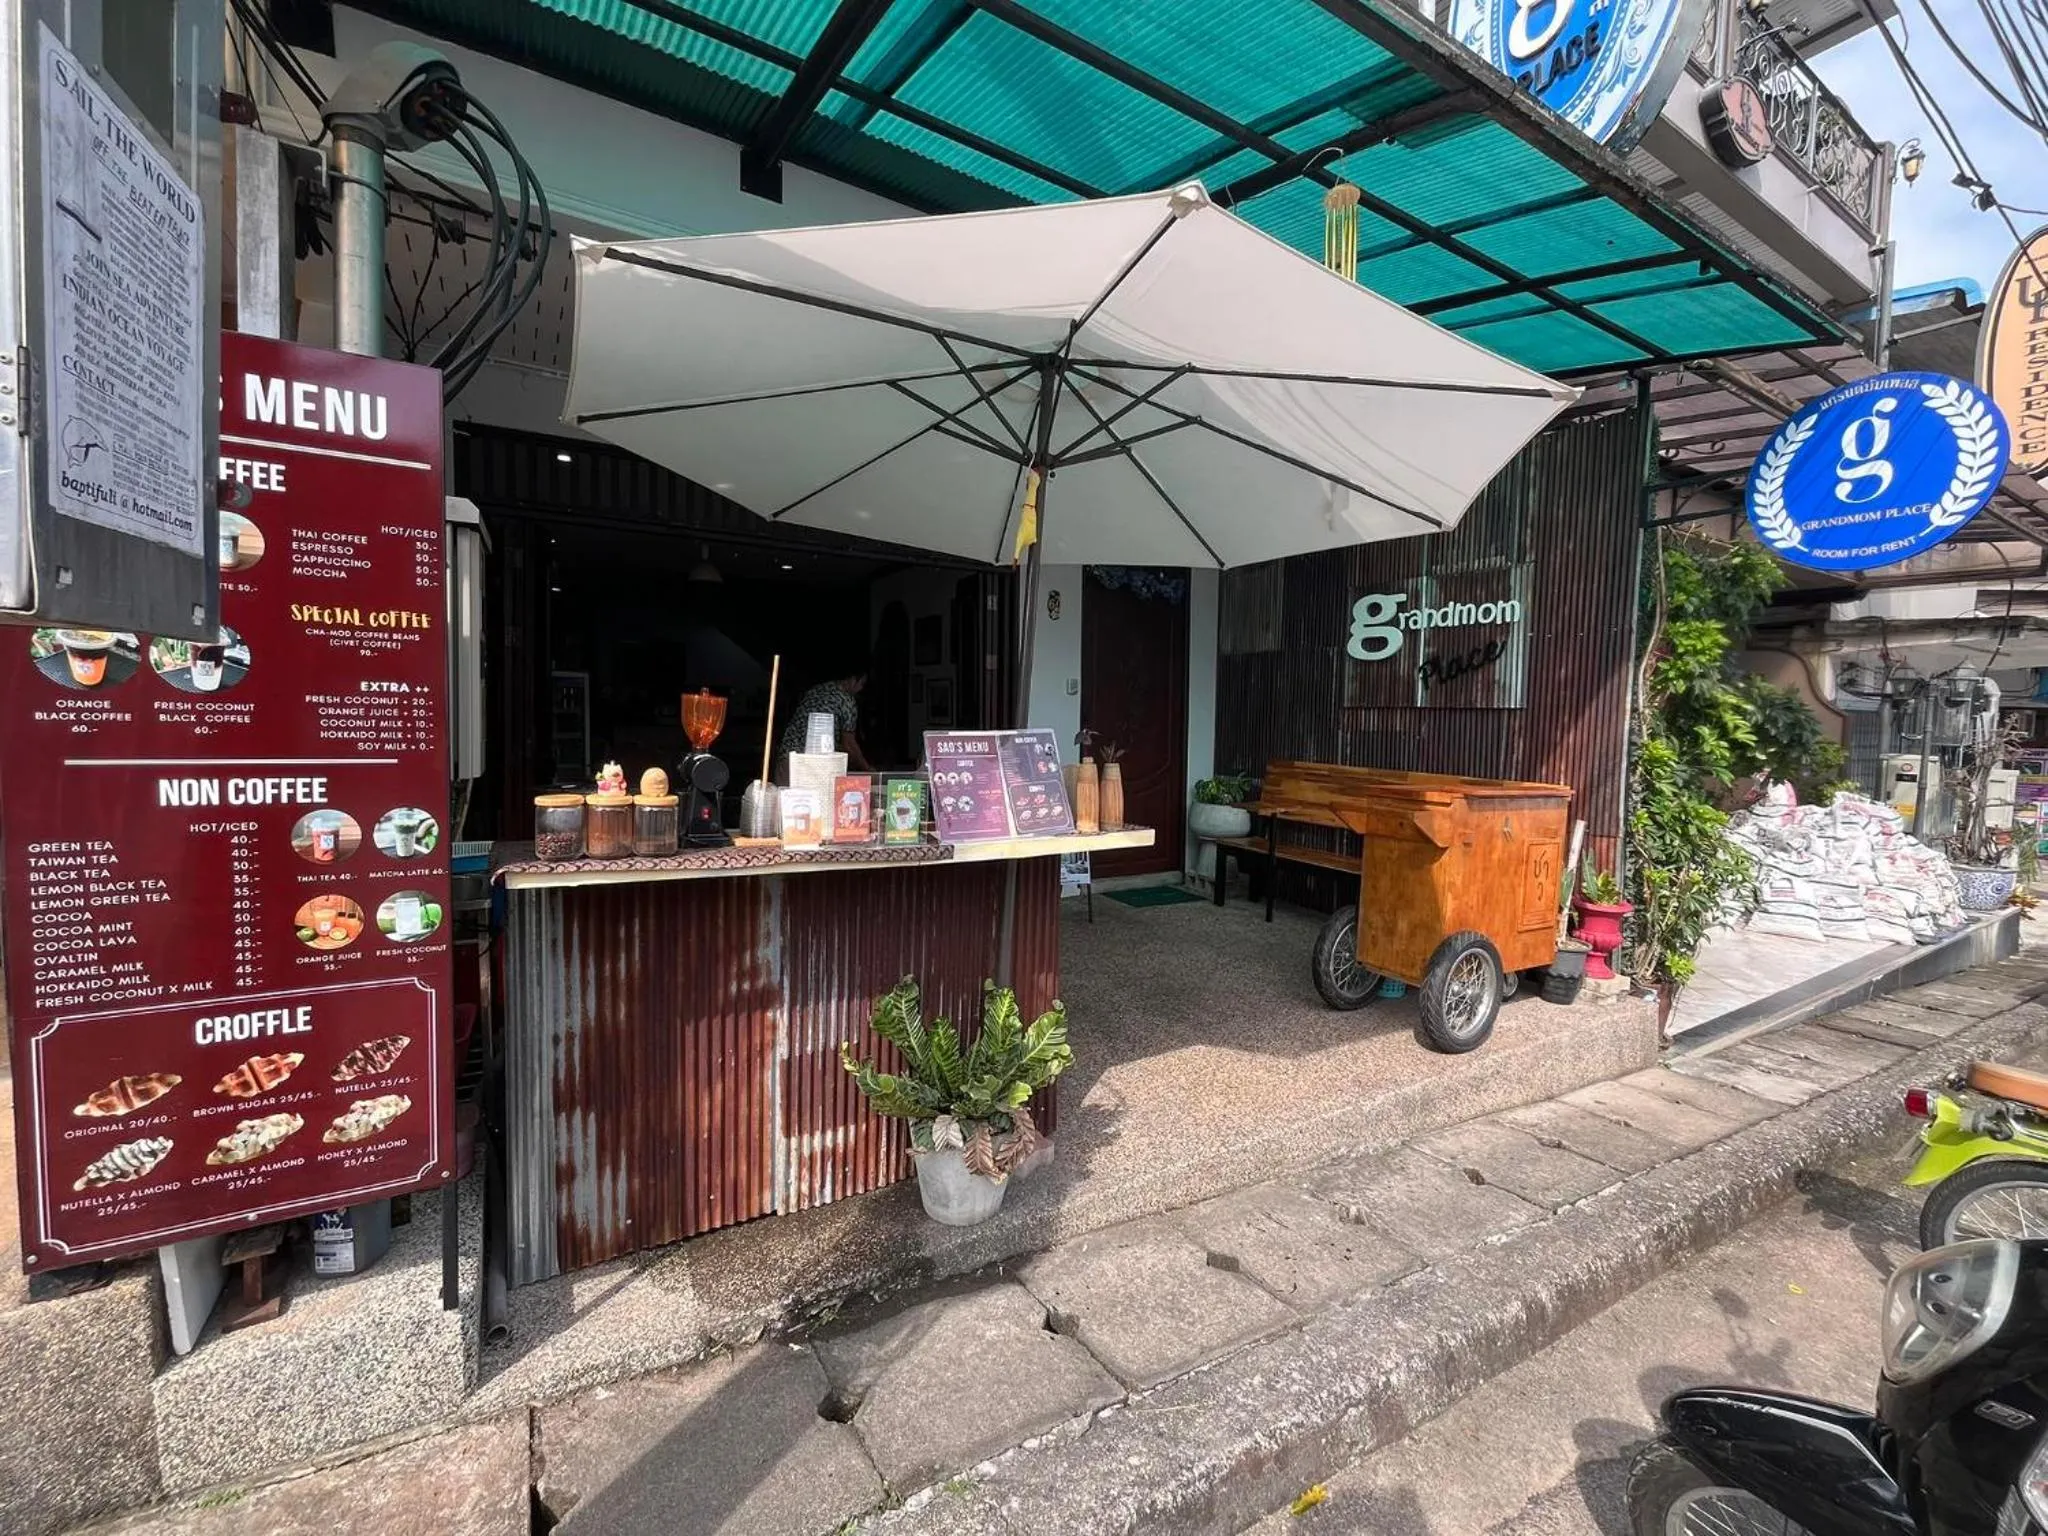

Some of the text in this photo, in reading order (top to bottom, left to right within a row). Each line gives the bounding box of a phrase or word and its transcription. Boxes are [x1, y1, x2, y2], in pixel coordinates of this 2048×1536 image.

[55, 59, 100, 125] SAIL
[103, 112, 138, 166] THE
[142, 155, 195, 224] WORLD
[86, 250, 110, 278] JOIN
[113, 273, 132, 296] SEA
[135, 291, 186, 339] ADVENTURE
[62, 273, 105, 316] INDIAN
[108, 308, 145, 344] OCEAN
[147, 335, 185, 375] VOYAGE
[63, 355, 115, 395] CONTACT
[245, 374, 387, 440] MENU
[1834, 397, 1899, 504] g
[219, 457, 285, 491] FFEE
[132, 498, 193, 532] hotmail.com
[1801, 503, 1933, 532] GRANDMOM PLACE
[292, 529, 317, 538] THAI
[322, 532, 367, 544] COFFEE
[382, 526, 437, 538] HOT/ICED
[292, 542, 353, 555] ESPRESSO
[1811, 536, 1918, 559] ROOM FOR RENT
[293, 554, 371, 568] CAPPUCCINO
[291, 604, 430, 628] SPECIAL COFFEE
[1347, 593, 1520, 660] grandmom
[355, 631, 388, 639] COFFEE
[361, 681, 409, 692] EXTRA
[56, 700, 110, 708] ORANGE
[154, 701, 254, 711] FRESH COCONUT
[306, 695, 340, 703] FRESH
[344, 696, 398, 704] COCONUT
[35, 712, 131, 721] BLACK COFFEE
[205, 715, 250, 723] COFFEE
[319, 707, 364, 715] ORANGE
[370, 708, 398, 716] JUICE
[320, 719, 375, 727] COCONUT
[358, 742, 380, 750] SOY
[964, 742, 989, 753] MENU
[159, 778, 327, 806] NON COFFEE
[190, 822, 258, 833] HOT/ICED
[28, 843, 80, 852] GREEN
[86, 841, 113, 850] TEA
[29, 856, 85, 866] TAIWAN
[92, 855, 118, 863] TEA
[30, 871, 77, 881] BLACK
[84, 869, 110, 878] TEA
[31, 885, 83, 896] LEMON
[90, 882, 134, 892] BLACK
[141, 880, 166, 888] TEA
[32, 899, 84, 909] LEMON
[90, 895, 139, 905] GREEN
[145, 893, 170, 901] TEA
[32, 912, 92, 923] COCOA
[33, 926, 93, 937] COCOA
[99, 922, 132, 932] MINT
[34, 940, 93, 952] COCOA
[100, 936, 136, 946] LAVA
[405, 945, 446, 954] COCONUT
[34, 953, 97, 966] OVALTIN
[296, 952, 361, 964] ORANGE JUICE
[35, 966, 106, 980] CARAMEL
[112, 962, 143, 972] MILK
[36, 979, 113, 995] HOKKAIDO
[119, 975, 150, 985] MILK
[36, 996, 83, 1008] FRESH
[89, 986, 163, 1002] COCONUT
[183, 981, 212, 992] MILK
[195, 1006, 312, 1045] CROFFLE
[336, 1082, 376, 1094] NUTELLA
[193, 1105, 233, 1117] BROWN
[238, 1098, 275, 1109] SUGAR
[64, 1123, 124, 1139] ORIGINAL
[318, 1149, 353, 1162] HONEY
[366, 1139, 407, 1153] ALMOND
[192, 1170, 246, 1186] CARAMEL
[260, 1158, 305, 1172] ALMOND
[61, 1196, 113, 1212] NUTELLA
[130, 1182, 180, 1198] ALMOND
